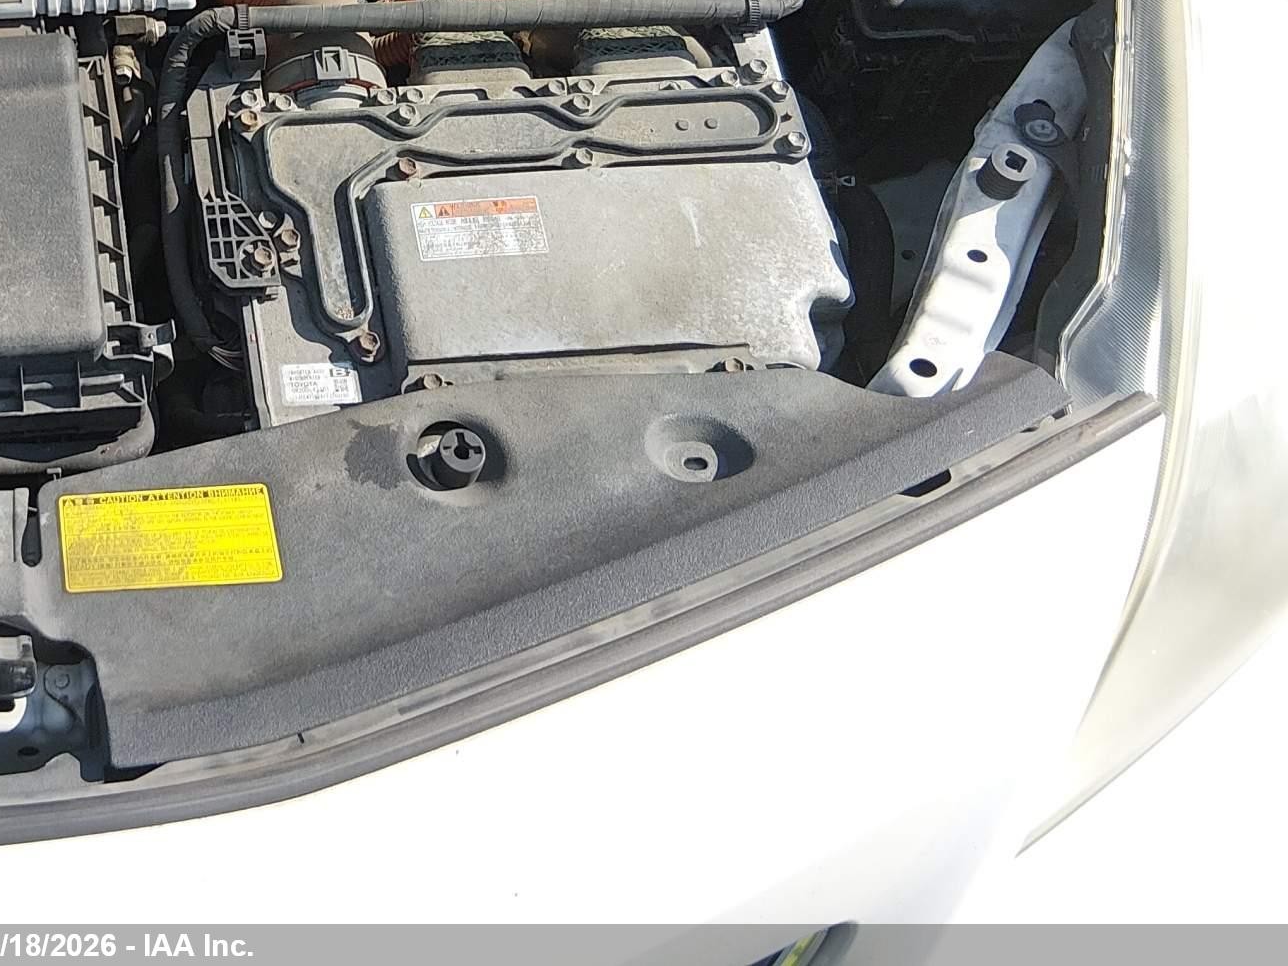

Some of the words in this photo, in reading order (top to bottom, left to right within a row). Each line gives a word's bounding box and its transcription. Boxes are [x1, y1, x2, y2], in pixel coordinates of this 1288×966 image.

[99, 495, 143, 505] CAUTION
[147, 491, 204, 502] ATTENTION
[207, 488, 262, 498] ВНИМАНИЕ
